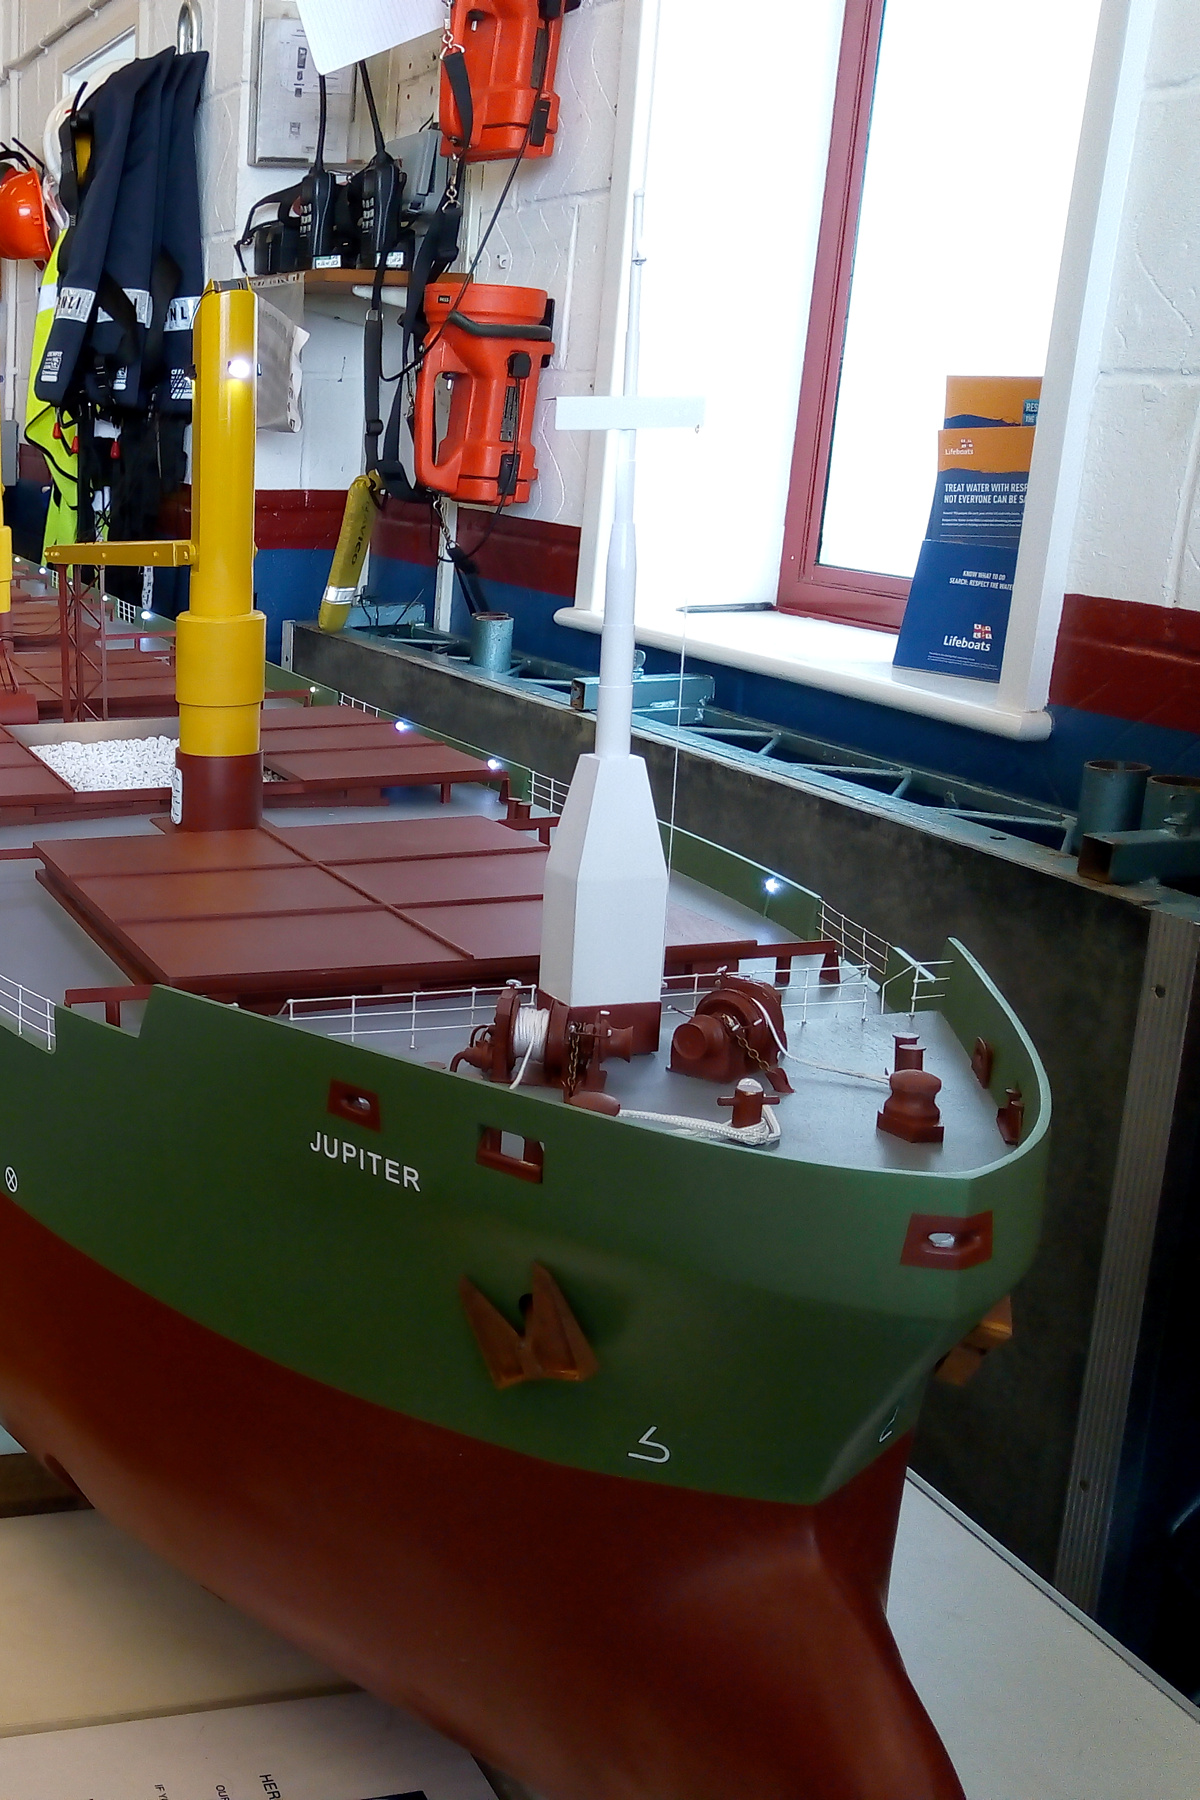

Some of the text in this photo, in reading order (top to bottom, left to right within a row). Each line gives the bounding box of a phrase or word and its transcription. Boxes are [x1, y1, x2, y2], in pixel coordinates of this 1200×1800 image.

[945, 448, 974, 456] Lifeboats
[945, 483, 965, 492] TREAT
[966, 483, 990, 493] WATER
[991, 483, 1010, 493] WITH
[944, 494, 1025, 504] NOT EVERYONE CAN BE S
[963, 570, 977, 578] KNOW
[969, 579, 990, 588] RESPECT
[943, 635, 991, 652] Lifeboats
[309, 1131, 421, 1192] JUPITER
